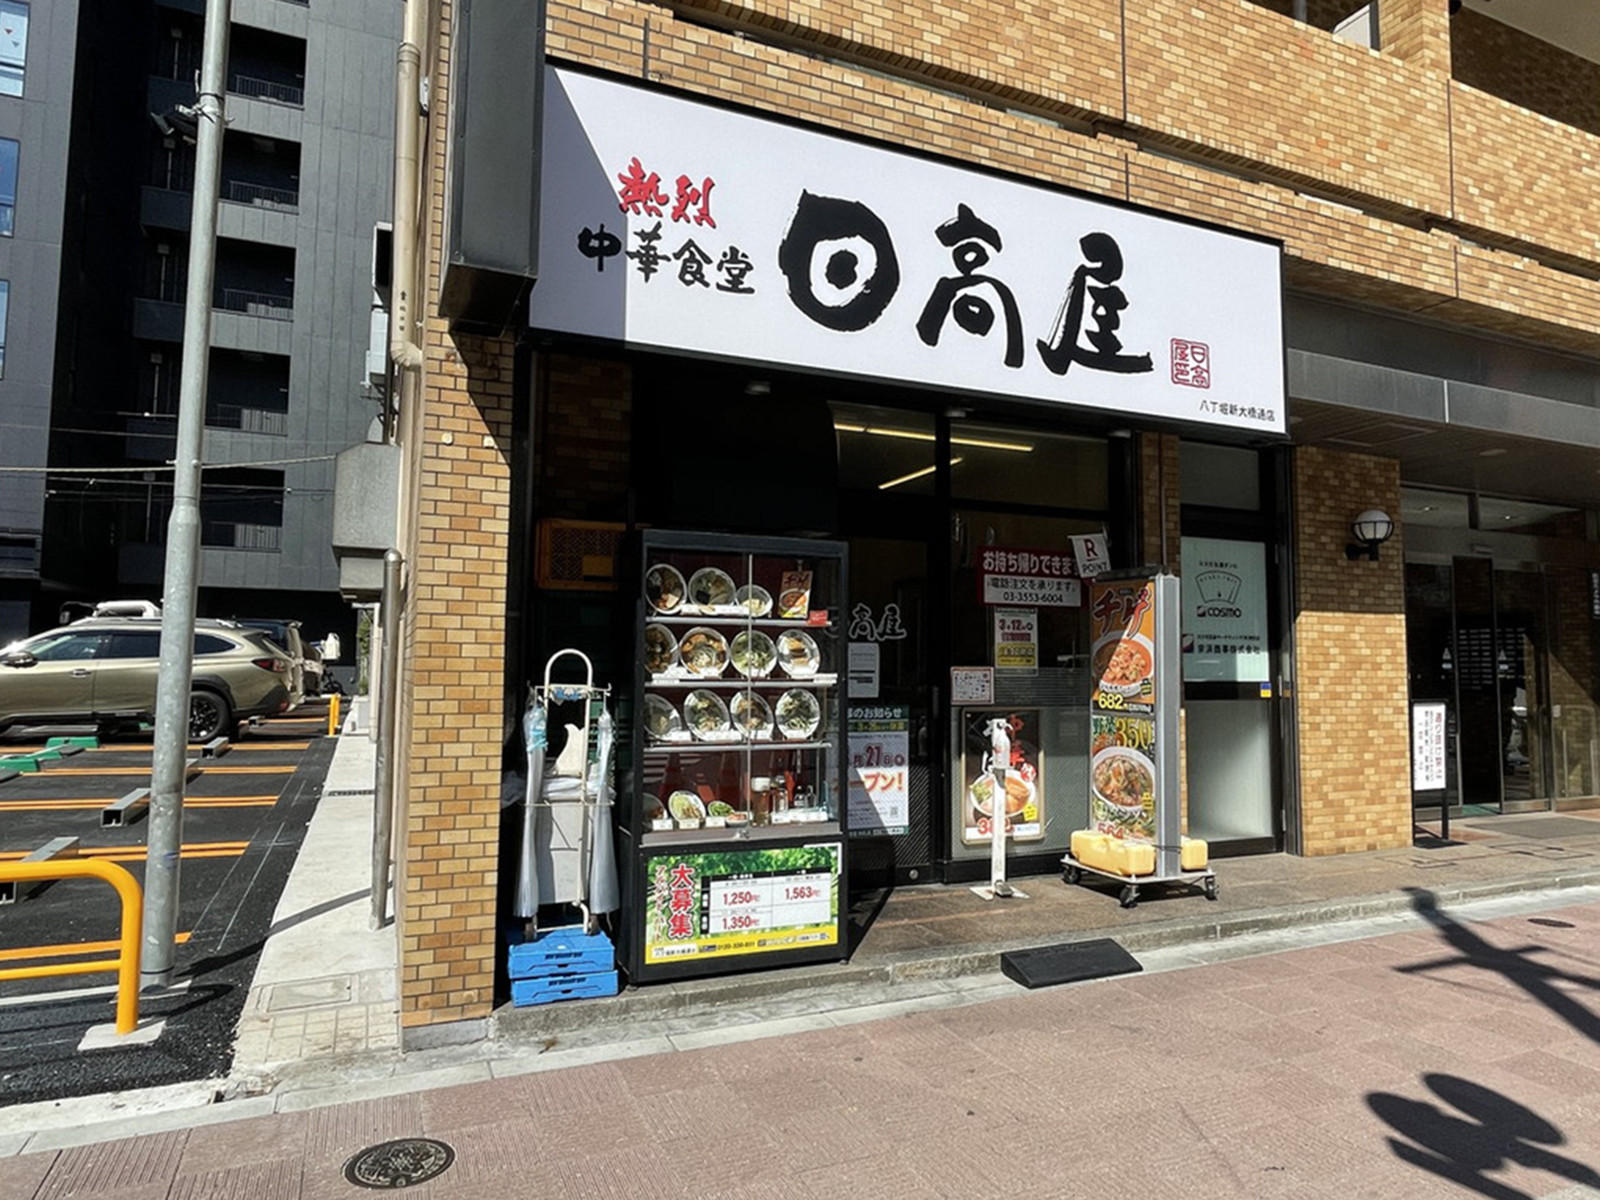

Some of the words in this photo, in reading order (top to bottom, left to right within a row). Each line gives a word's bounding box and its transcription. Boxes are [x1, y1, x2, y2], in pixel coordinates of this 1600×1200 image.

[618, 157, 717, 229] 熱烈
[577, 221, 756, 295] 中華食堂
[778, 188, 1153, 376] 日高屋
[1199, 400, 1276, 422] 八丁堀新大橋通店
[1083, 538, 1098, 558] R
[1081, 561, 1107, 575] POINT
[1003, 591, 1064, 603] 03-3553-6004
[1098, 692, 1124, 710] 682
[672, 864, 695, 938] 大募集
